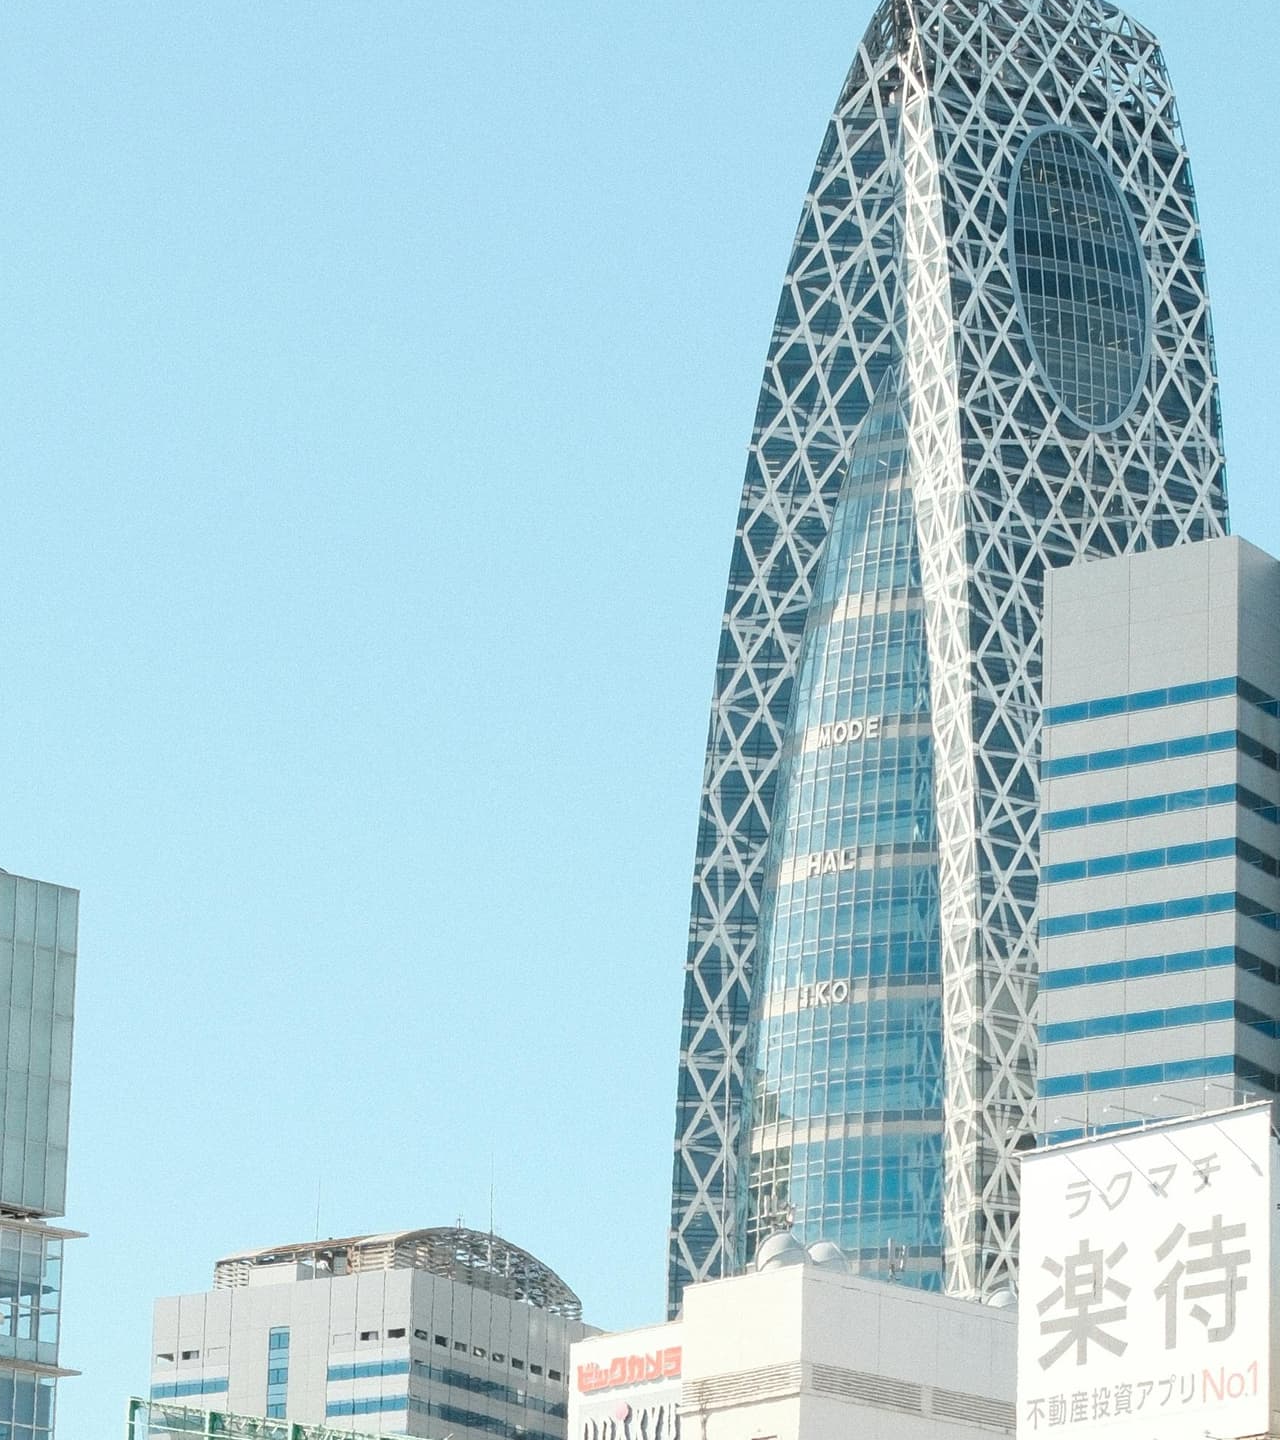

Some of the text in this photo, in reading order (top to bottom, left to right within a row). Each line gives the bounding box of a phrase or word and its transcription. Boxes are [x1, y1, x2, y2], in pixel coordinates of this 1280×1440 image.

[1064, 1150, 1223, 1220] ラクマチ
[1035, 1212, 1255, 1373] 楽待
[576, 1345, 683, 1394] ビックカメラ
[1025, 1359, 1261, 1430] 不動産投資アプリ No.1
